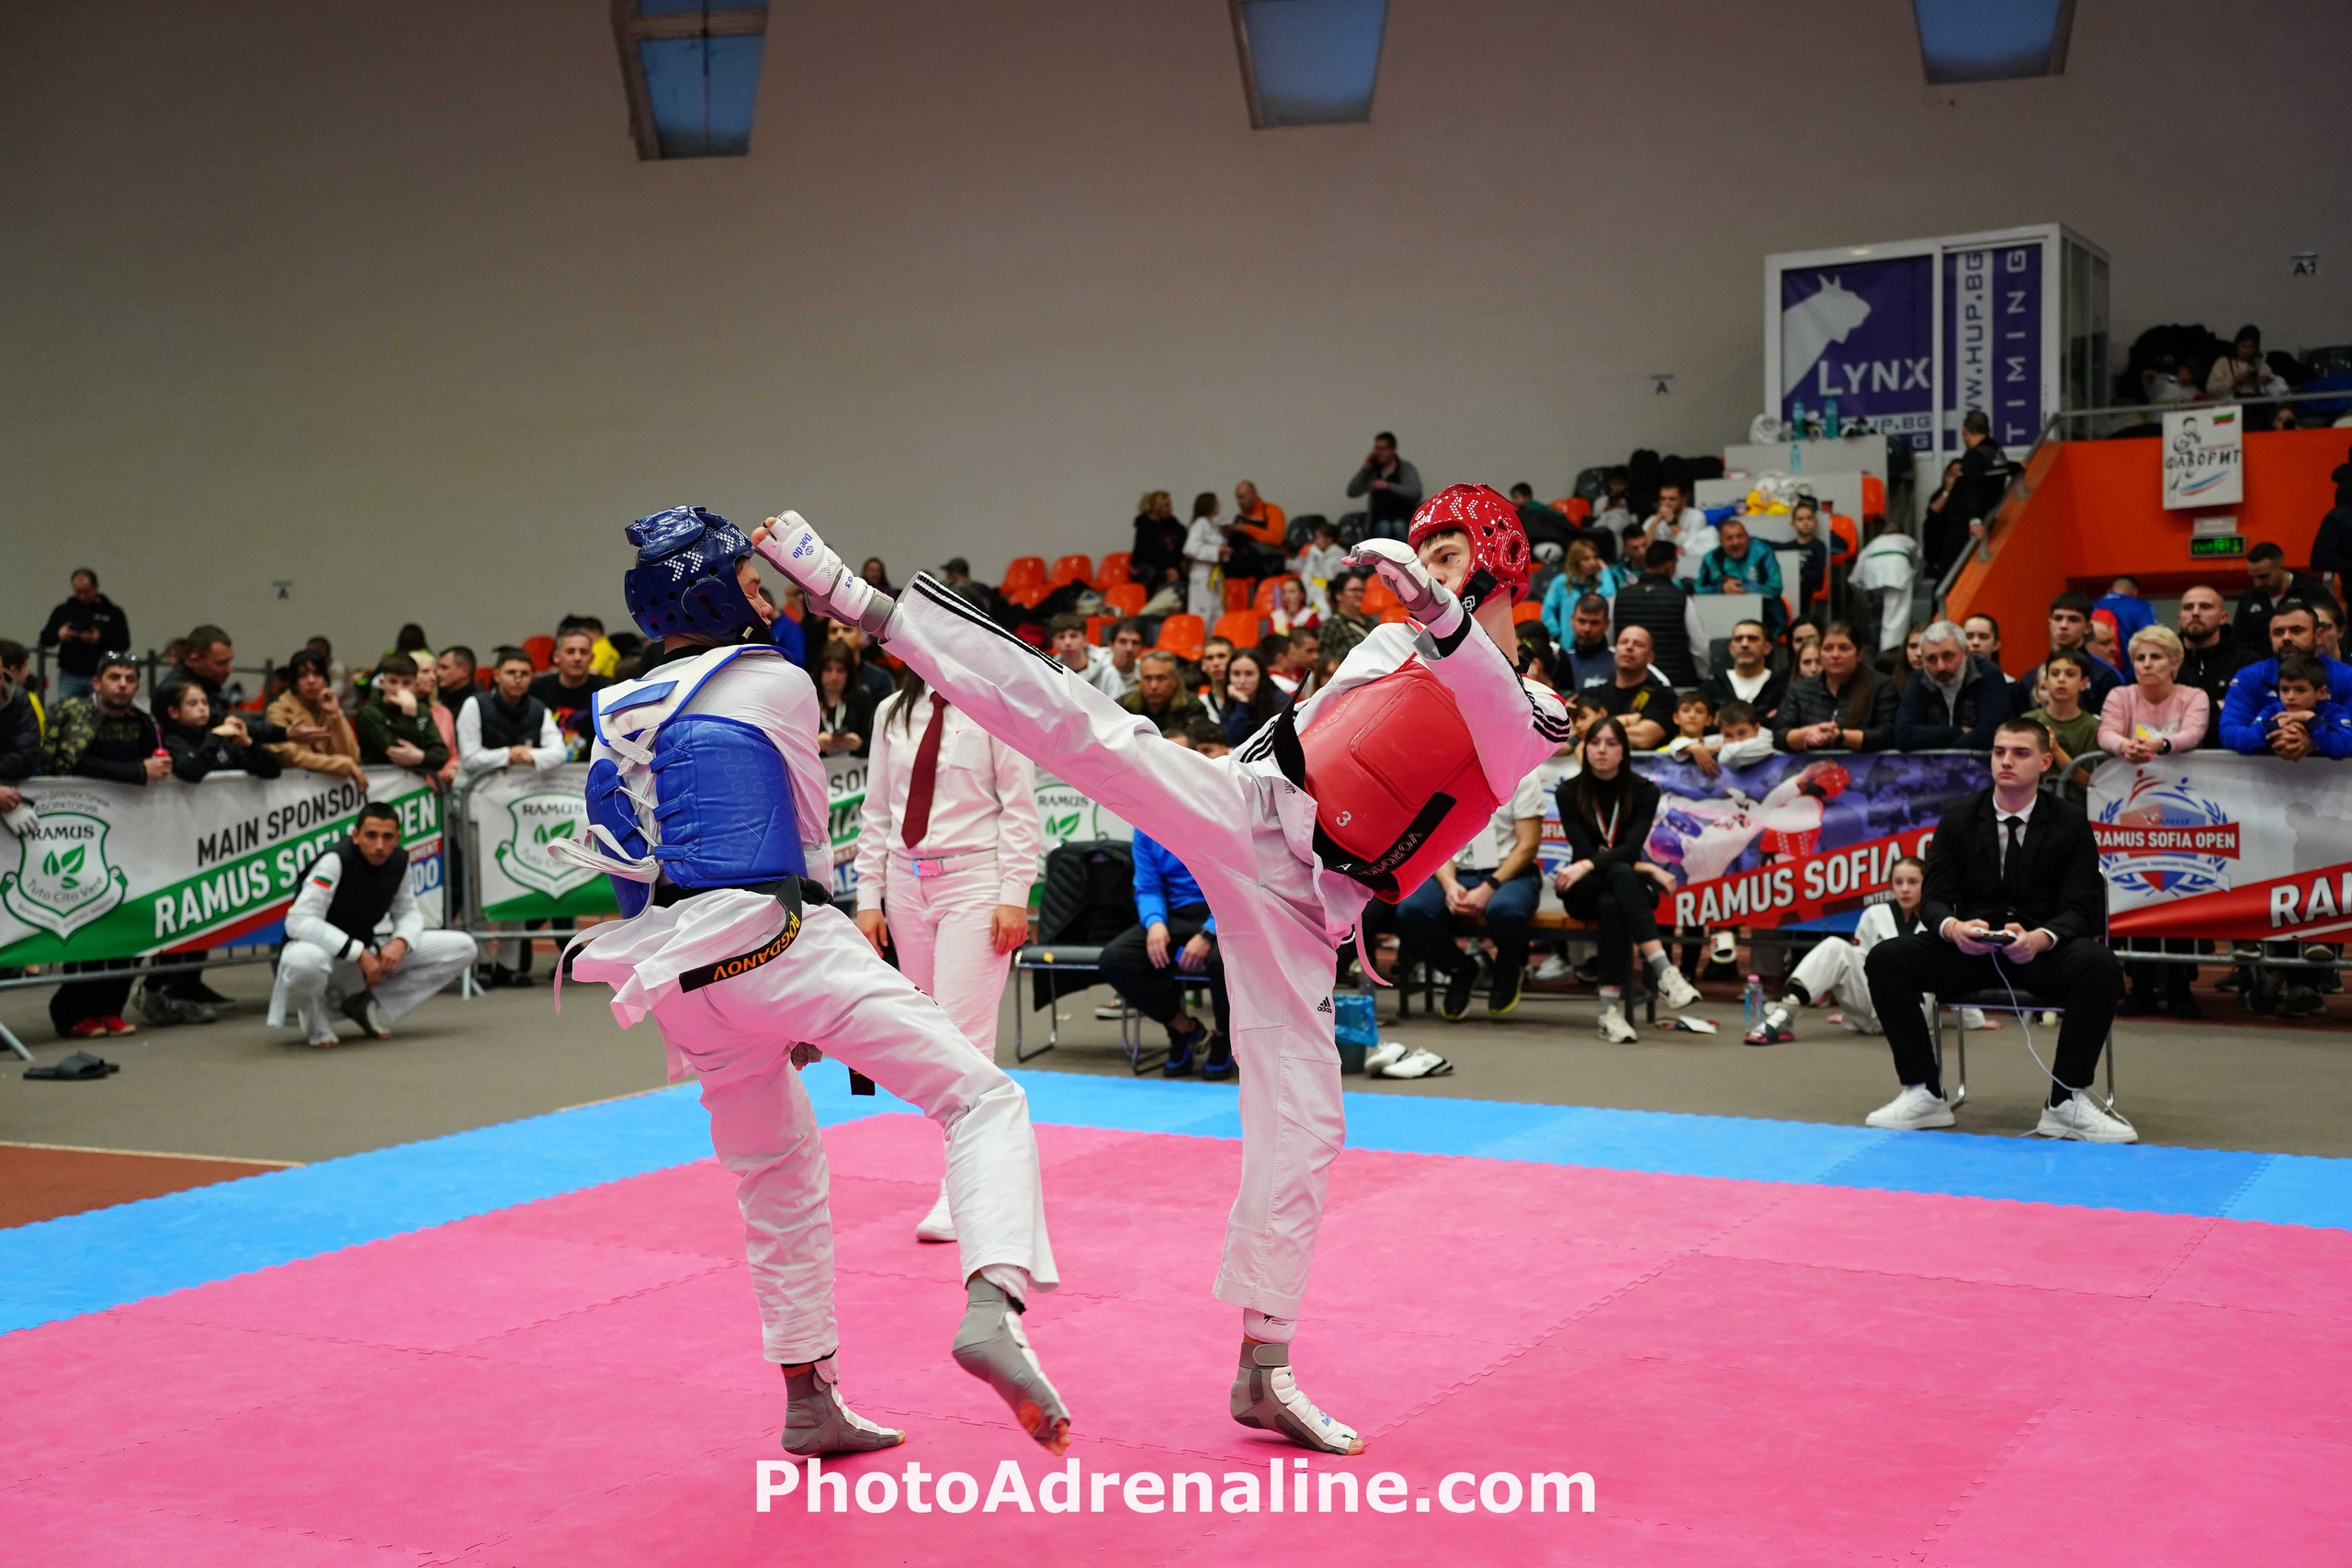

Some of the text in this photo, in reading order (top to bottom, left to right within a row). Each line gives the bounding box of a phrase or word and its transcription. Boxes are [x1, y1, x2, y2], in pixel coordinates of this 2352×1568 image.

[1818, 357, 1930, 397] LYNX
[31, 825, 95, 841] RAMUS
[1336, 810, 1352, 827] 3
[2094, 830, 2236, 849] RAMUS SOFIA OPEN
[197, 817, 259, 867] MAIN
[153, 857, 272, 940] RAMUS
[1675, 867, 1794, 928] RAMUS
[1803, 840, 1903, 900] SOFIA
[713, 910, 801, 983] BOGDANOV
